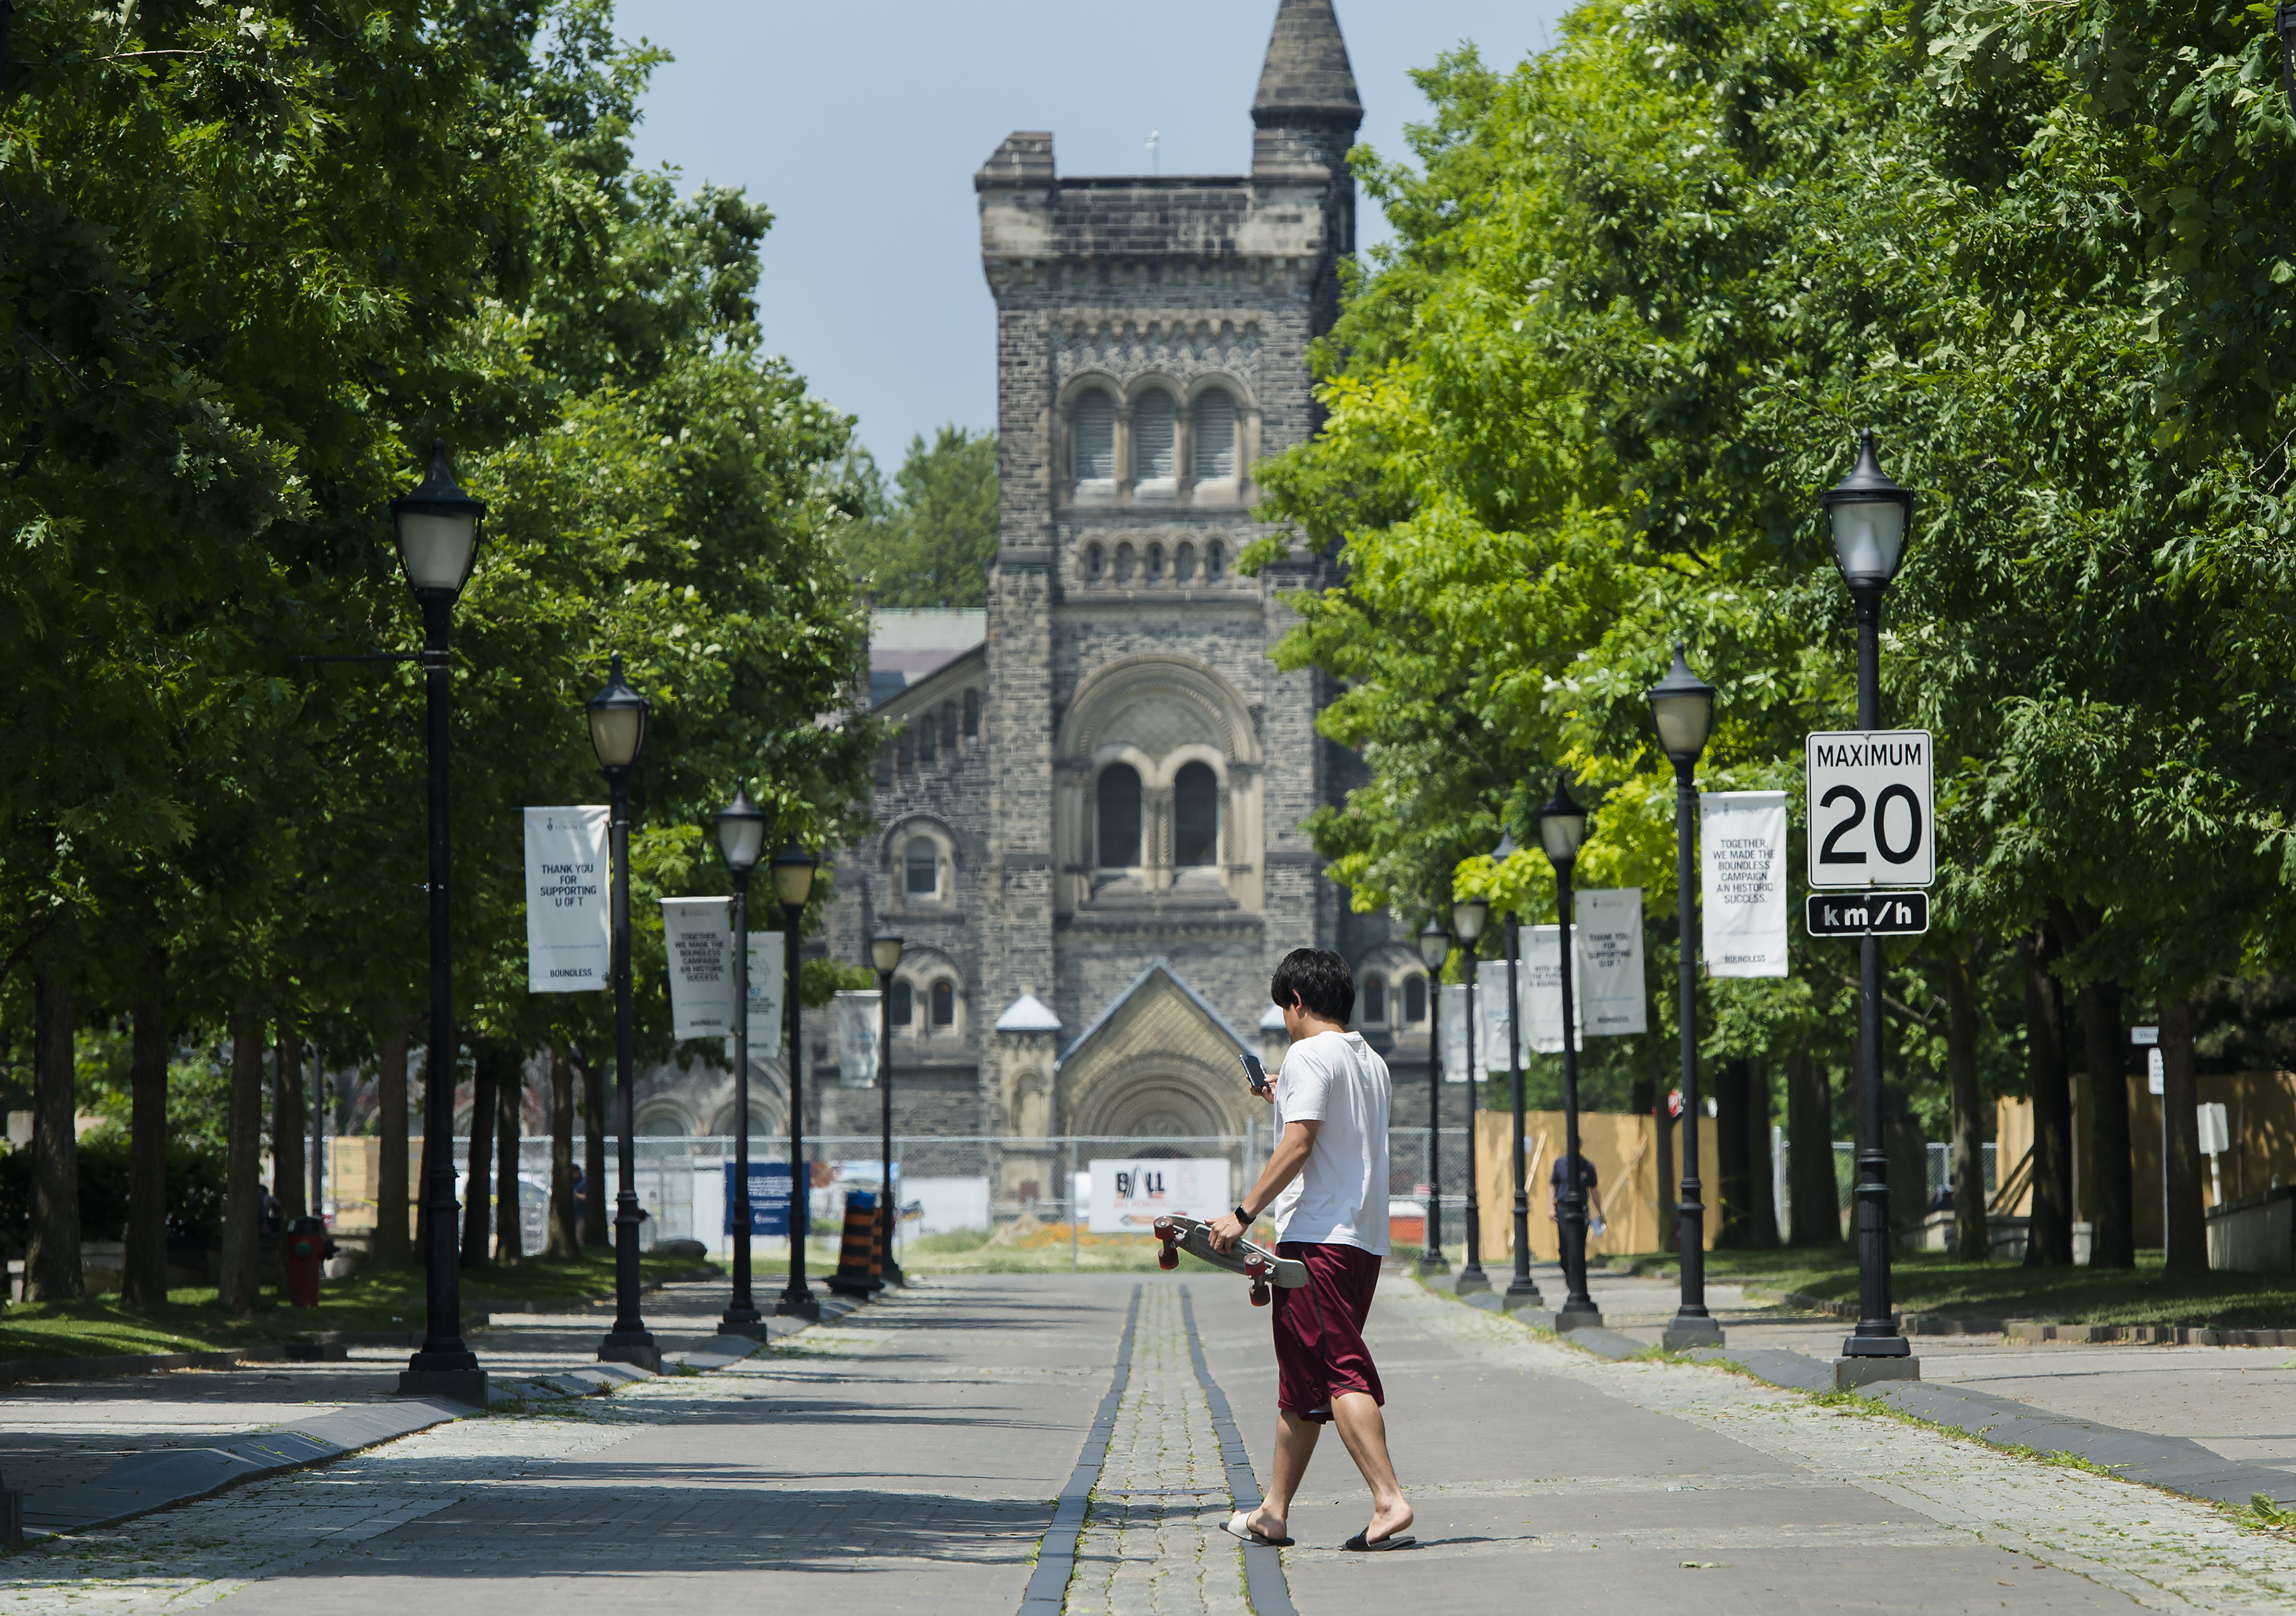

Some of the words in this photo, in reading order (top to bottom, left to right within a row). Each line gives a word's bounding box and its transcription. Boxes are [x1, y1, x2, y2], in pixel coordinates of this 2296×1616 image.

[1817, 743, 1921, 767] MAXIMUM
[1819, 783, 1922, 864] 20
[1713, 851, 1727, 860] WE
[1730, 849, 1755, 859] MADE
[1758, 849, 1775, 859] THE
[541, 863, 573, 874] THANK
[575, 863, 594, 873] YOU
[1718, 861, 1770, 870] BOUNDLESS
[560, 875, 577, 885] FOR
[1721, 872, 1768, 881] CAMPAIGN
[540, 885, 597, 897] SUPPORTING
[1716, 883, 1730, 892] AN
[1733, 883, 1773, 892] HISTORIC
[555, 897, 563, 907] U
[564, 897, 575, 907] OF
[577, 896, 584, 906] T
[1725, 893, 1767, 904] SUCCESS.
[1823, 901, 1913, 927] km/h
[1725, 955, 1766, 963] BOUNDLESS
[550, 969, 592, 977] BOUNDLESS
